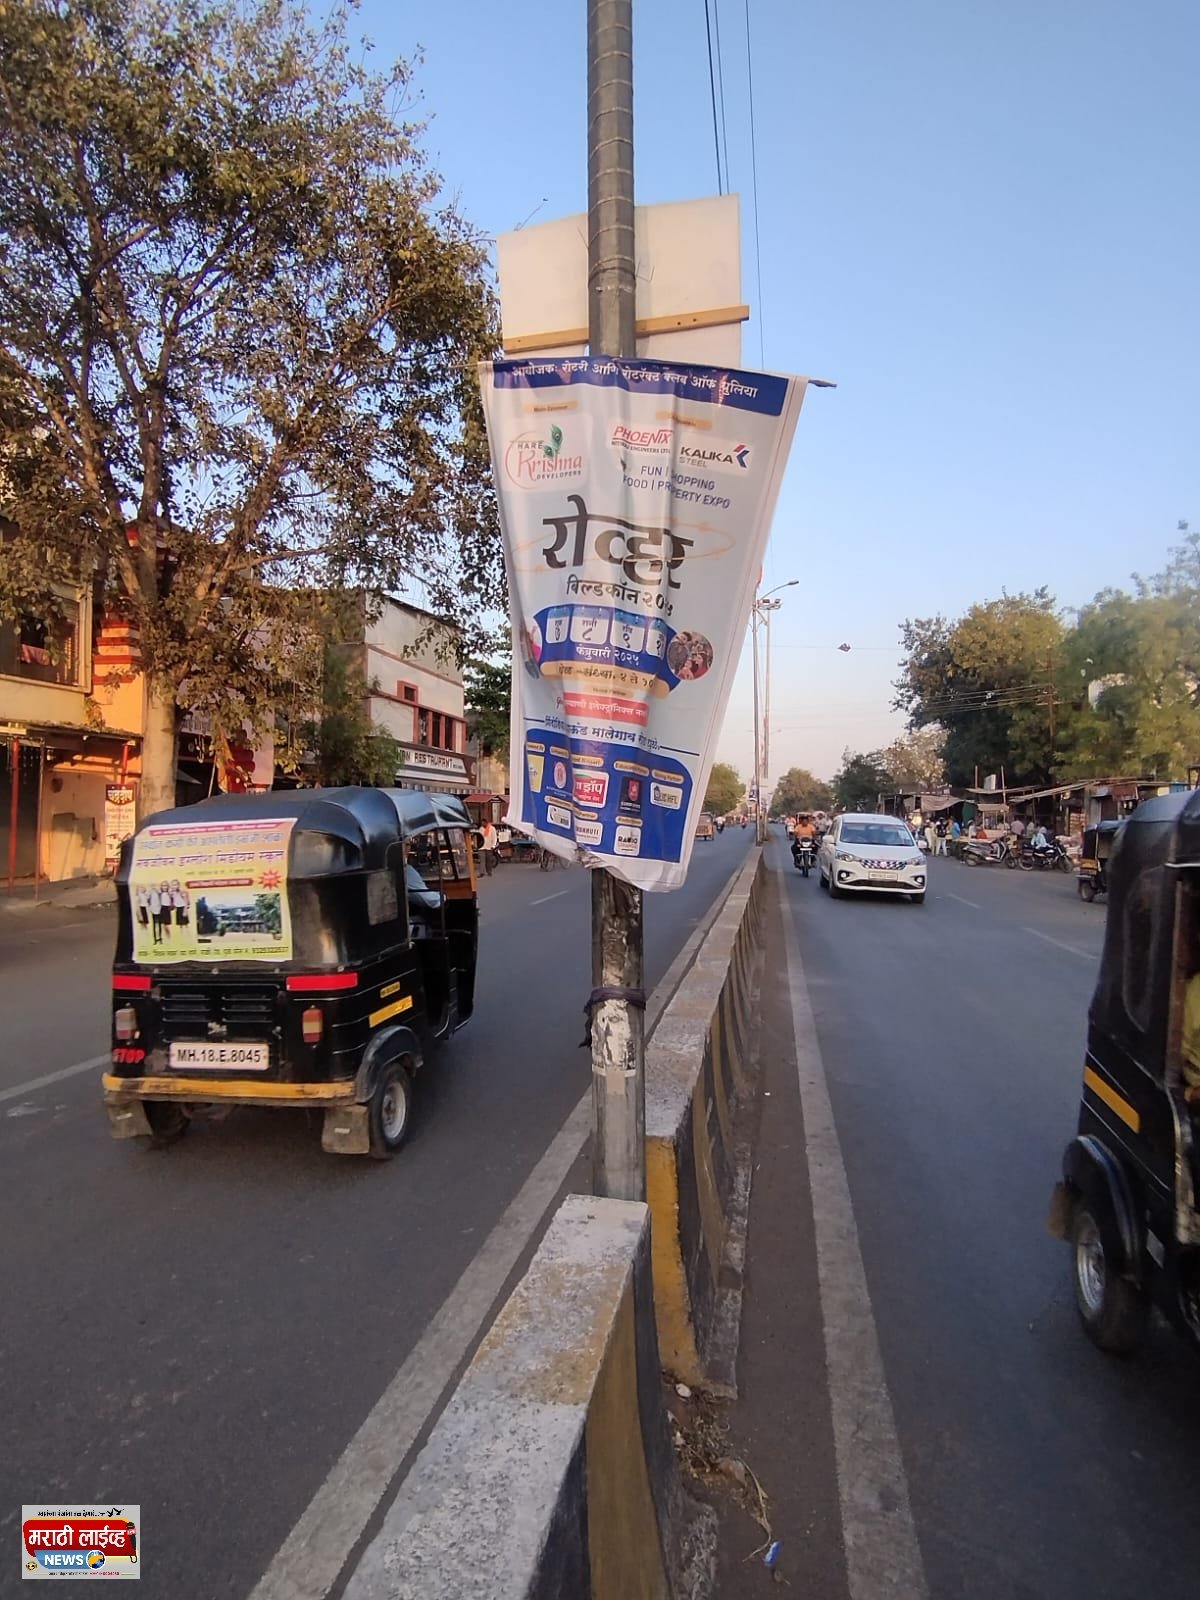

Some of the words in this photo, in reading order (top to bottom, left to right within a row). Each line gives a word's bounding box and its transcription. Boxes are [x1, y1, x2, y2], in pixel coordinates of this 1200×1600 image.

[561, 359, 588, 373] रोटरी
[663, 371, 687, 385] क्लब
[690, 375, 717, 390] ऑफ
[613, 426, 674, 446] PHOENIX
[517, 440, 544, 450] HARE
[680, 446, 734, 464] KALIKA
[680, 457, 708, 468] STEEL
[517, 449, 582, 482] Krishna
[640, 465, 662, 476] FUN
[536, 470, 582, 480] DEVELOPERS
[702, 494, 731, 510] EXPO
[542, 494, 694, 590] रोव्हर
[566, 574, 641, 605] बिल्डकॉन
[177, 1048, 262, 1064] MH.18.E.8045
